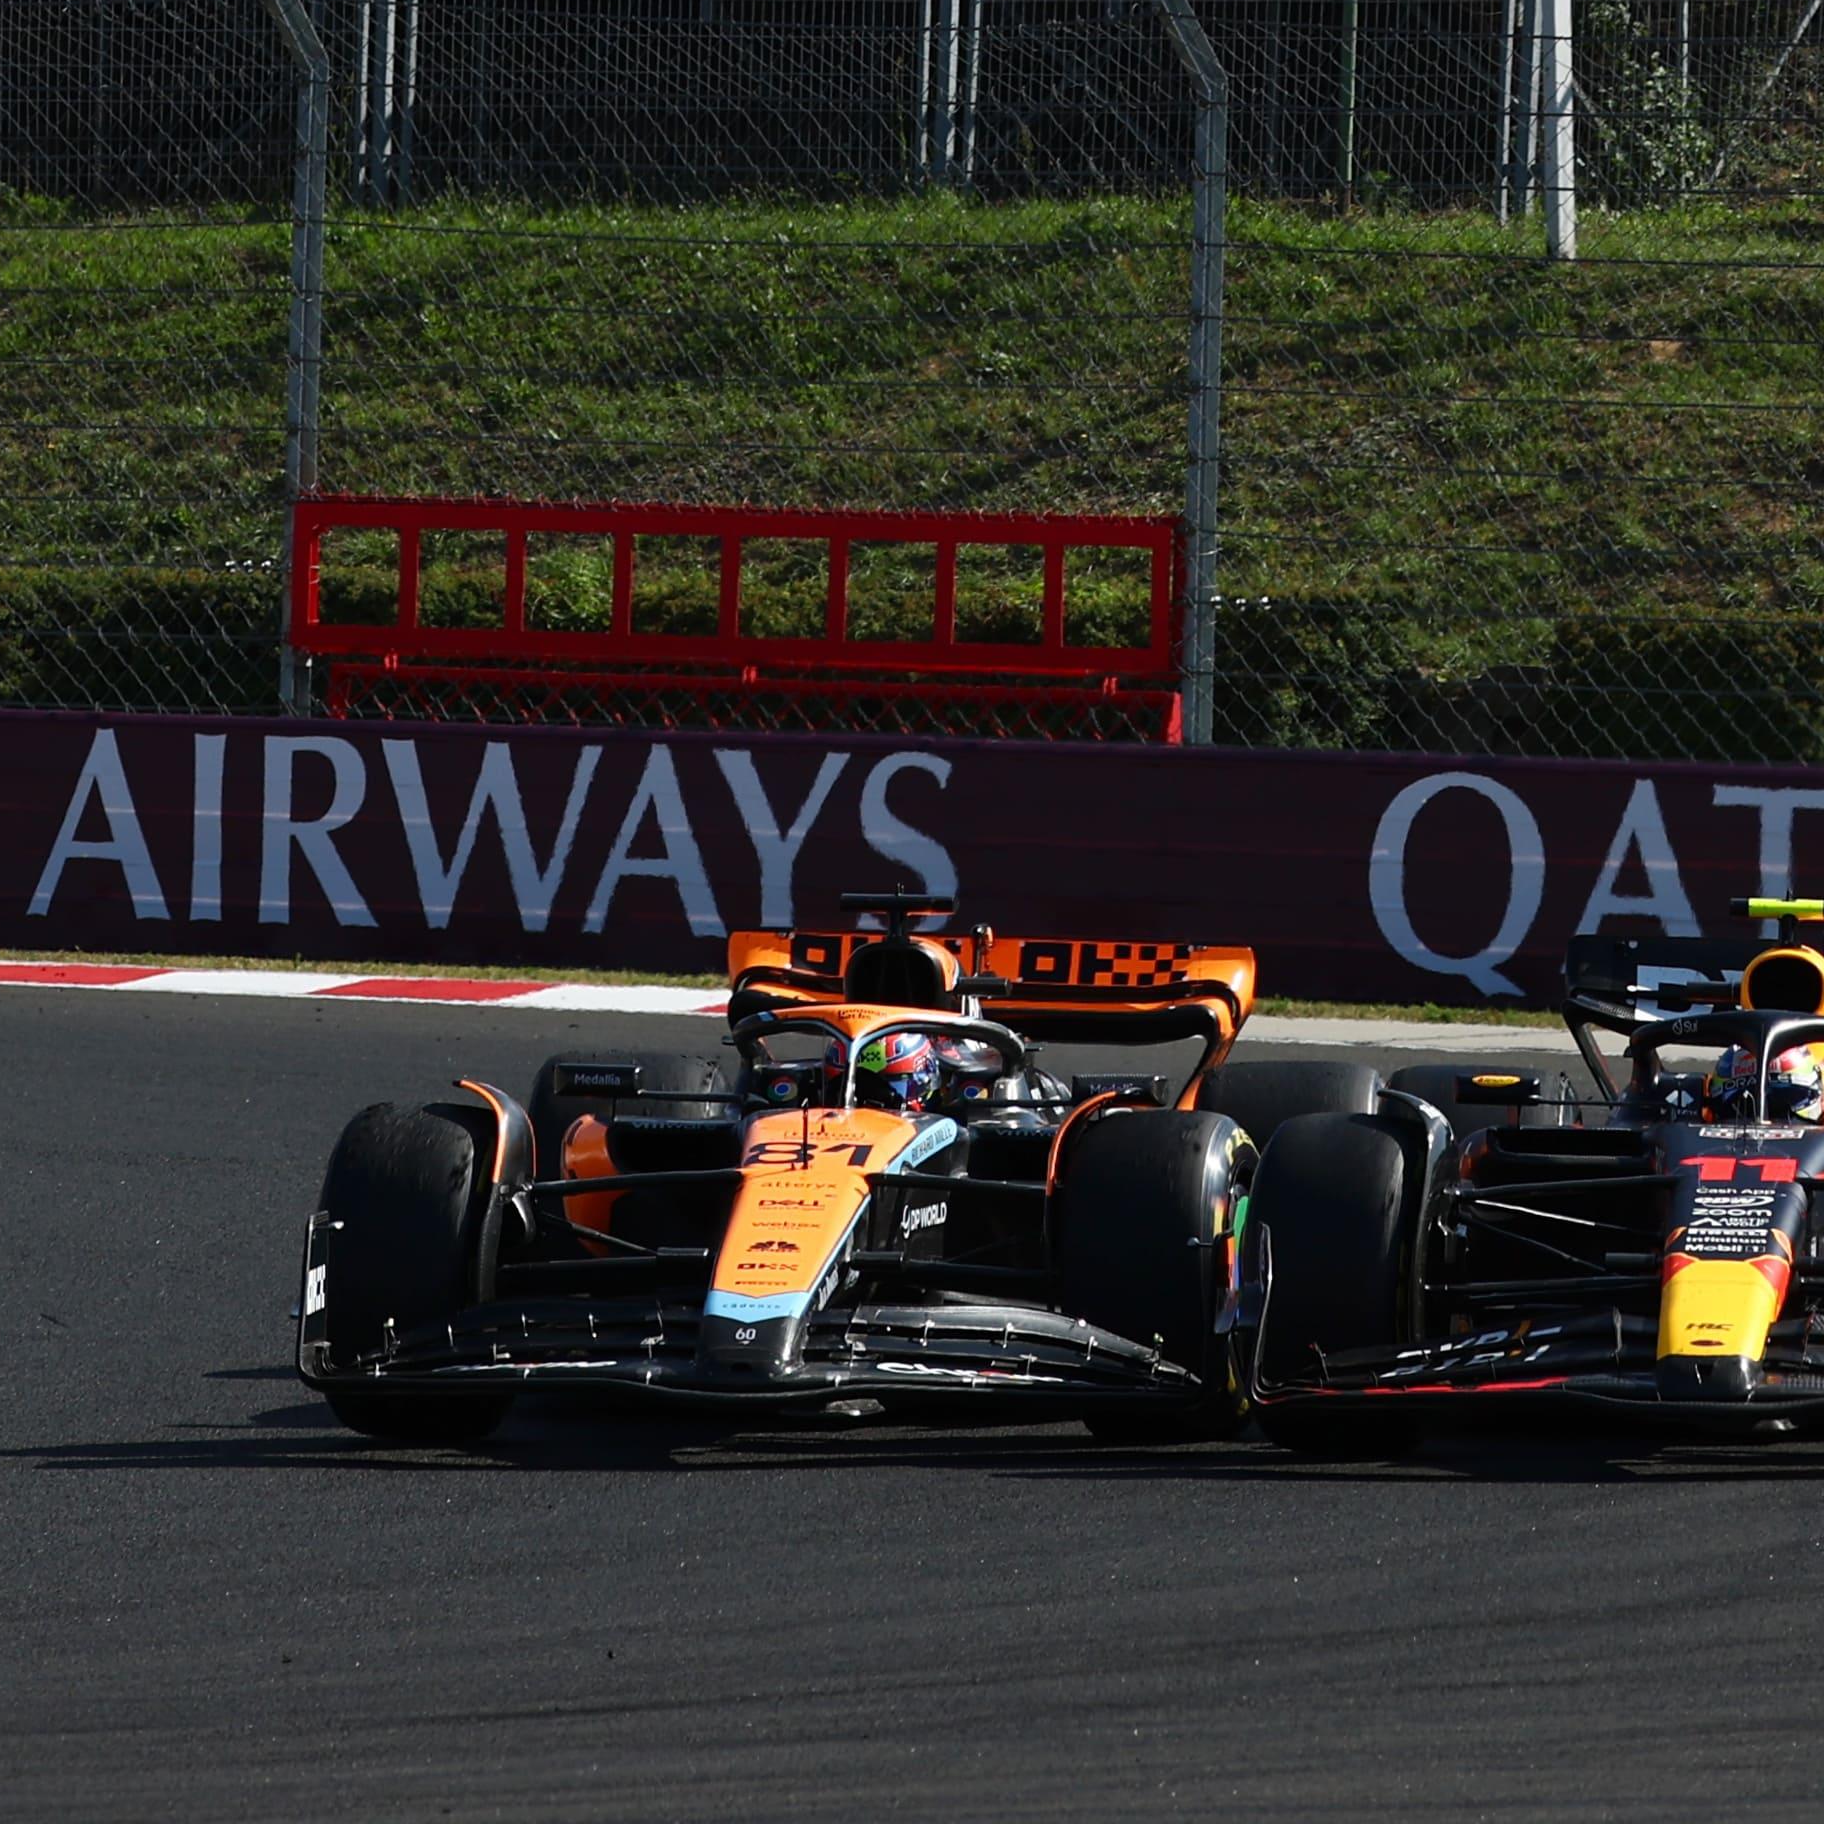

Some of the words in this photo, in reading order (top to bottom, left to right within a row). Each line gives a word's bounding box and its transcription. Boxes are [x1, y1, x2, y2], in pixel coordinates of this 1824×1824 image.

[24, 726, 959, 938] AIRWAYS
[573, 1073, 622, 1086] Medallia
[742, 1141, 875, 1168] 81
[1679, 1155, 1799, 1183] 11
[758, 1199, 823, 1207] DELL
[919, 1200, 947, 1226] WORLD
[1691, 1207, 1773, 1217] zoom
[1684, 1244, 1743, 1253] Mobil
[734, 1327, 757, 1340] 60
